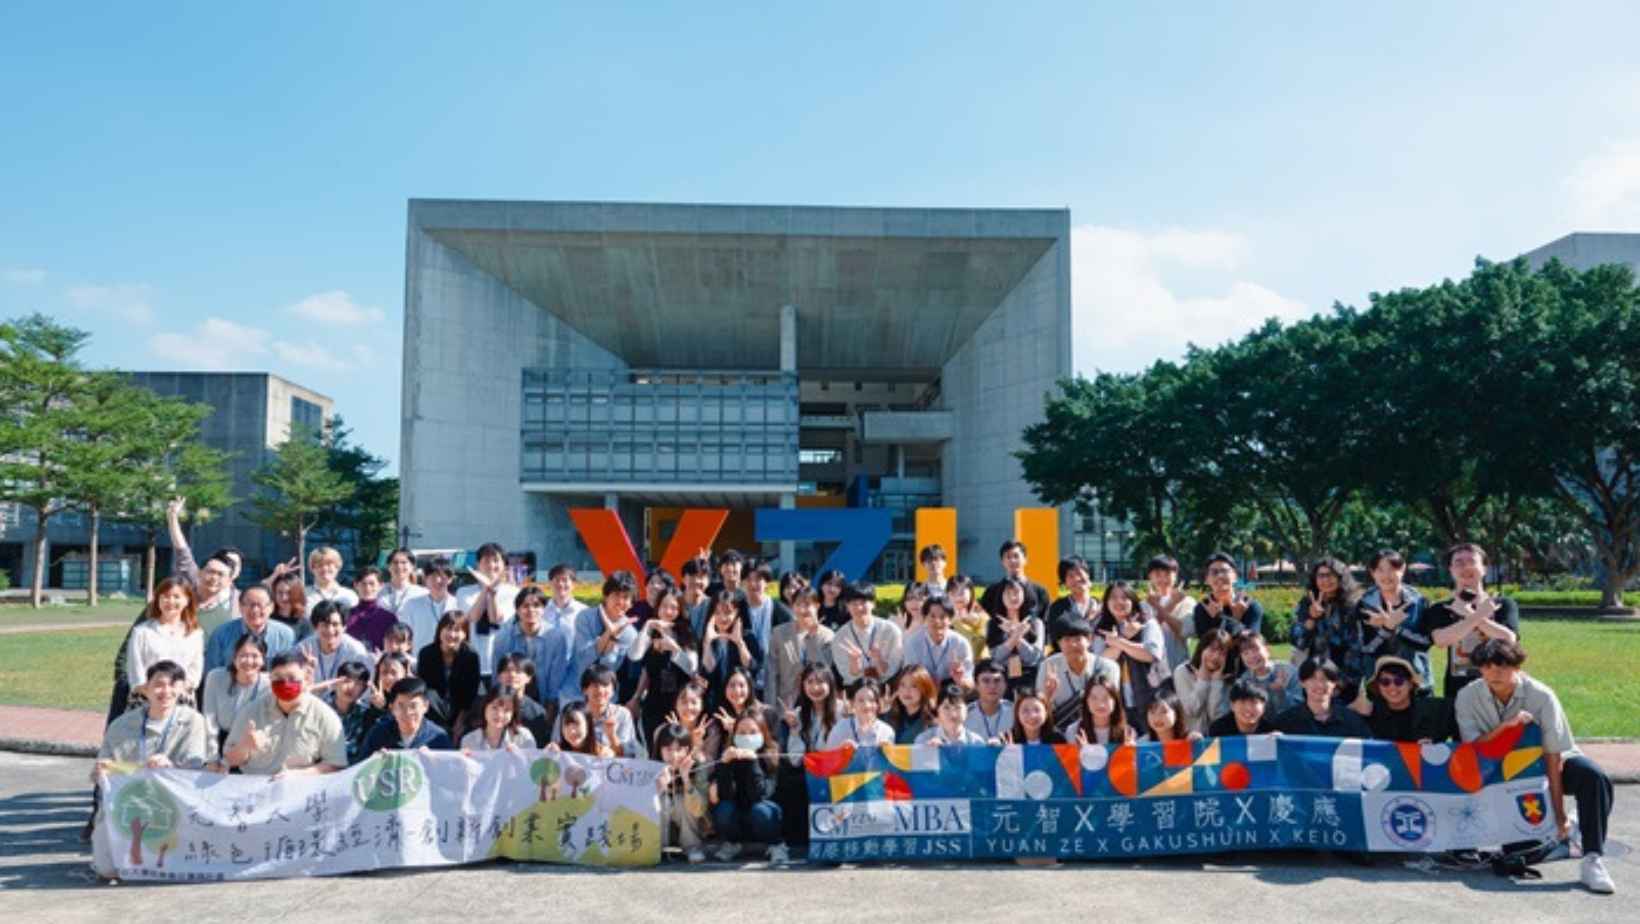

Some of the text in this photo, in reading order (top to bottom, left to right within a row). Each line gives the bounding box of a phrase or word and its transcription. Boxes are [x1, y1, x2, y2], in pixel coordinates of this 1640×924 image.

[894, 804, 965, 832] MBA
[923, 838, 961, 855] JSS
[986, 829, 1347, 853] YUAN ZE X GAKUSHUIN X KEIO
